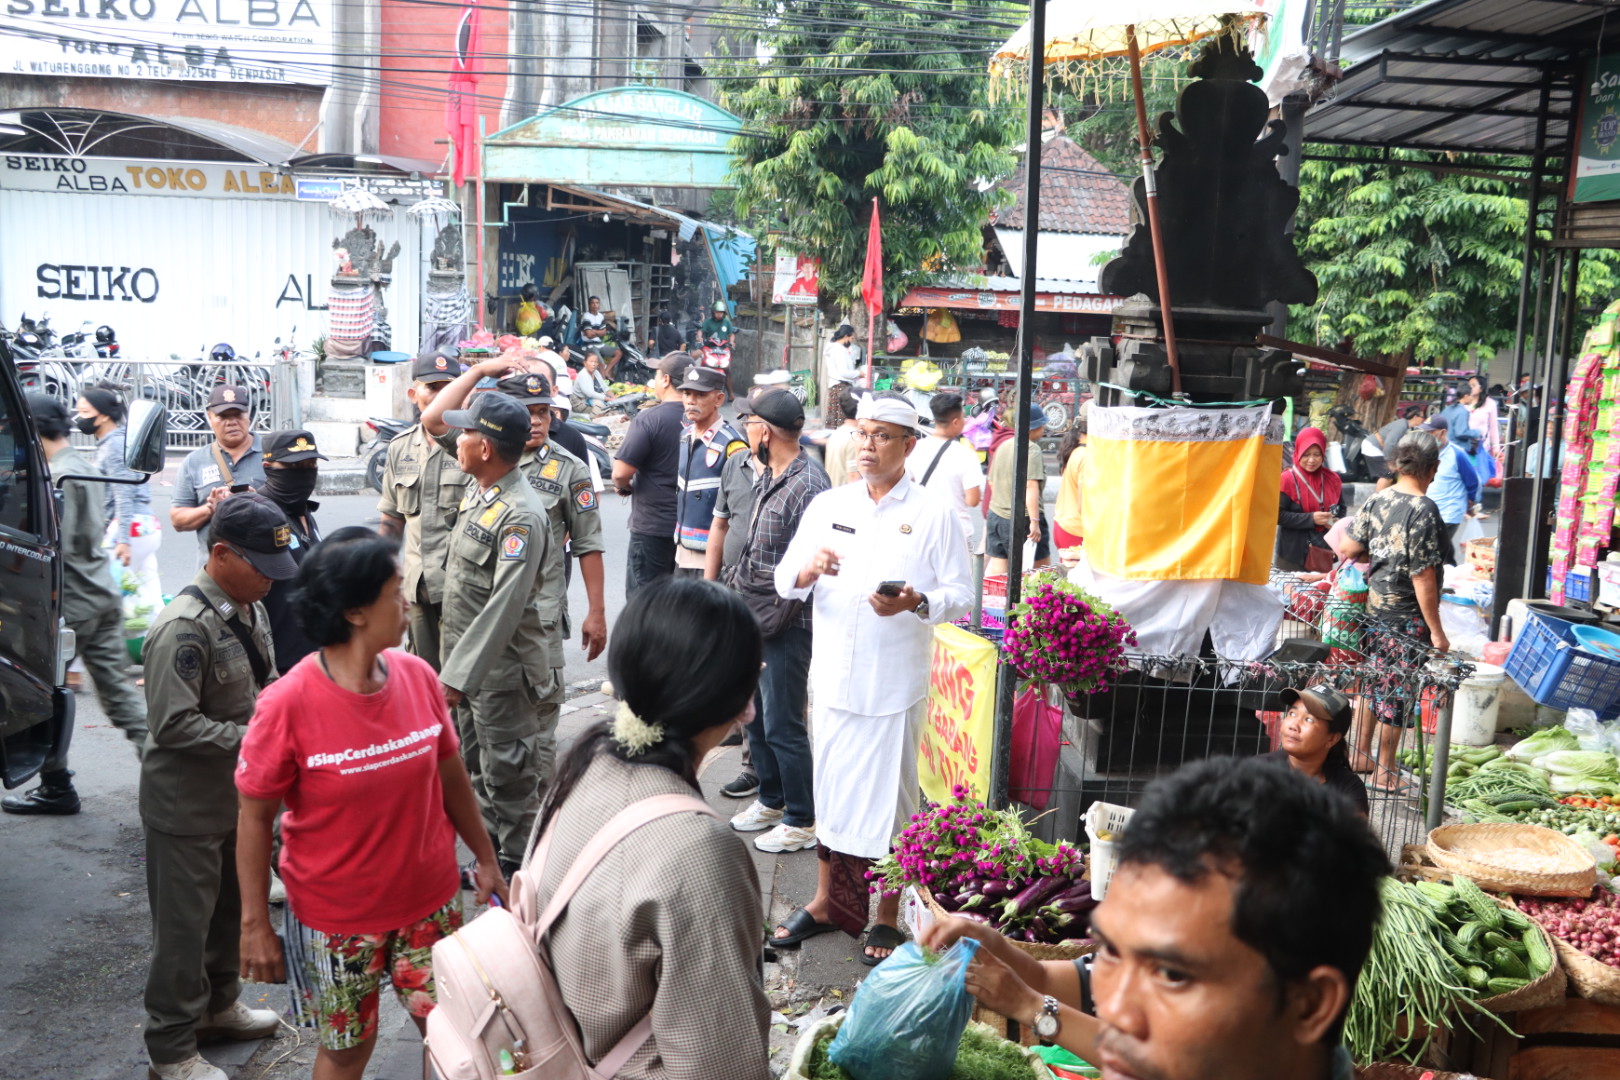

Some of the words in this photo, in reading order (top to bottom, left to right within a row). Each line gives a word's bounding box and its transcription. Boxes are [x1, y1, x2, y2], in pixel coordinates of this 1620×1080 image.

[176, 0, 321, 27] ALBA
[252, 35, 314, 44] CORPORATION
[131, 43, 232, 67] ALBA
[6, 156, 87, 174] SEIKO
[56, 174, 128, 192] ALBA
[126, 166, 208, 191] TOKO
[223, 170, 296, 195] ALBA
[36, 263, 160, 303] SEIKO
[1053, 294, 1125, 312] PEDAGAN
[530, 479, 547, 490] POL
[548, 483, 561, 493] PP
[466, 525, 480, 539] POL
[6, 543, 52, 564] INTERCOOLER
[340, 744, 433, 776] www.siapcerdaskan.com
